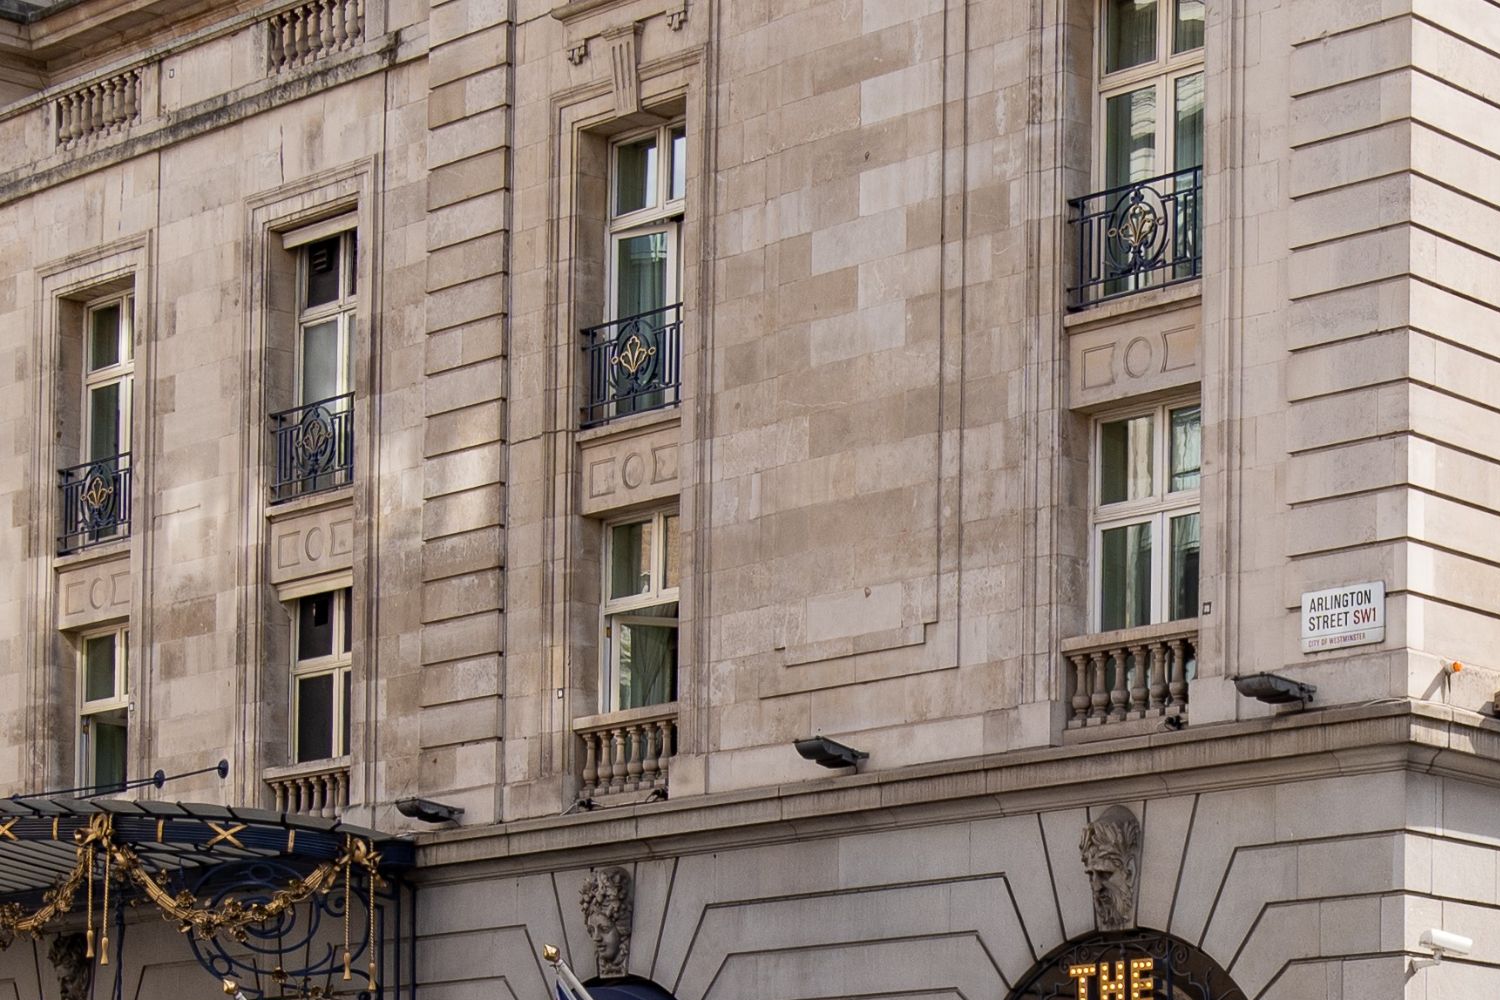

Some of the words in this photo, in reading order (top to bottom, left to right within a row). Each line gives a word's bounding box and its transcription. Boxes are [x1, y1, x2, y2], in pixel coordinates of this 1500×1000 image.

[1309, 590, 1371, 612] ARLINGTON
[1308, 612, 1349, 631] STREET
[1353, 608, 1376, 624] SW1
[1308, 637, 1320, 648] CITY
[1321, 637, 1328, 646] OF
[1329, 633, 1365, 644] WESTMINSTER
